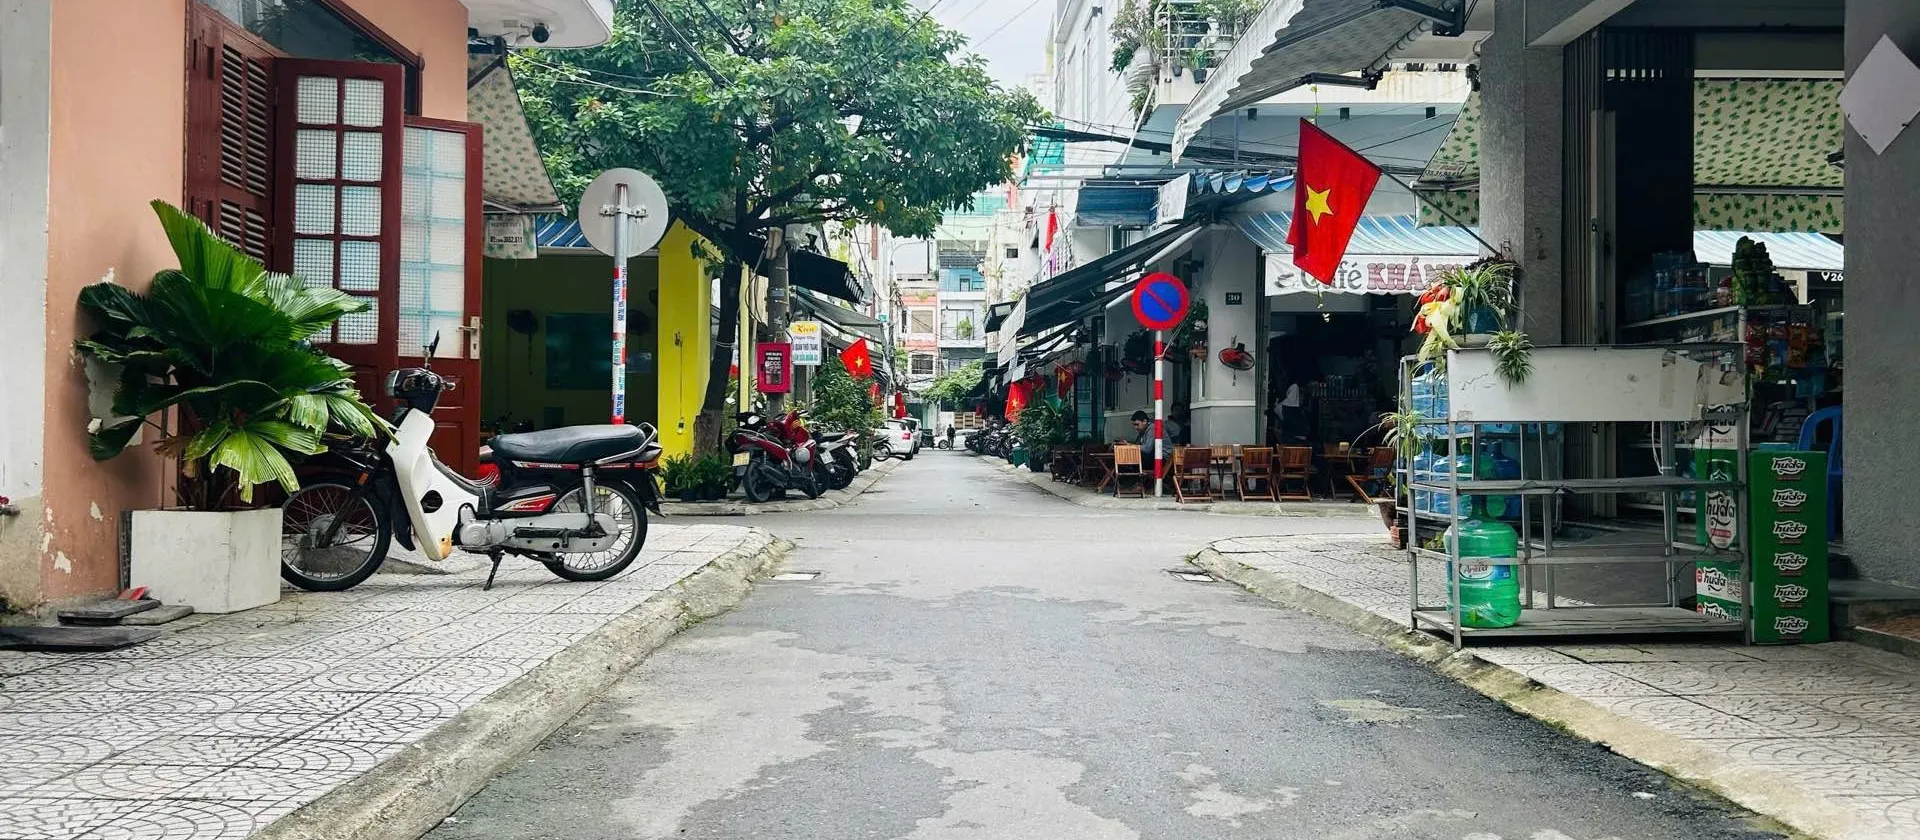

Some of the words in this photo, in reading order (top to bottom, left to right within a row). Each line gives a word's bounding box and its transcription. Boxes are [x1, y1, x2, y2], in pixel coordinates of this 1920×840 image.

[1301, 260, 1362, 290] Cfé
[1367, 257, 1462, 291] KHÁN
[1830, 272, 1844, 282] 26
[1227, 294, 1240, 302] 30
[1772, 457, 1806, 475] huda
[1773, 488, 1807, 506] huda
[1706, 491, 1735, 527] huda
[1774, 521, 1807, 539] huda
[1774, 552, 1808, 571] huda
[1703, 568, 1727, 592] huda
[1775, 584, 1808, 602] huda
[1775, 616, 1808, 635] huda
